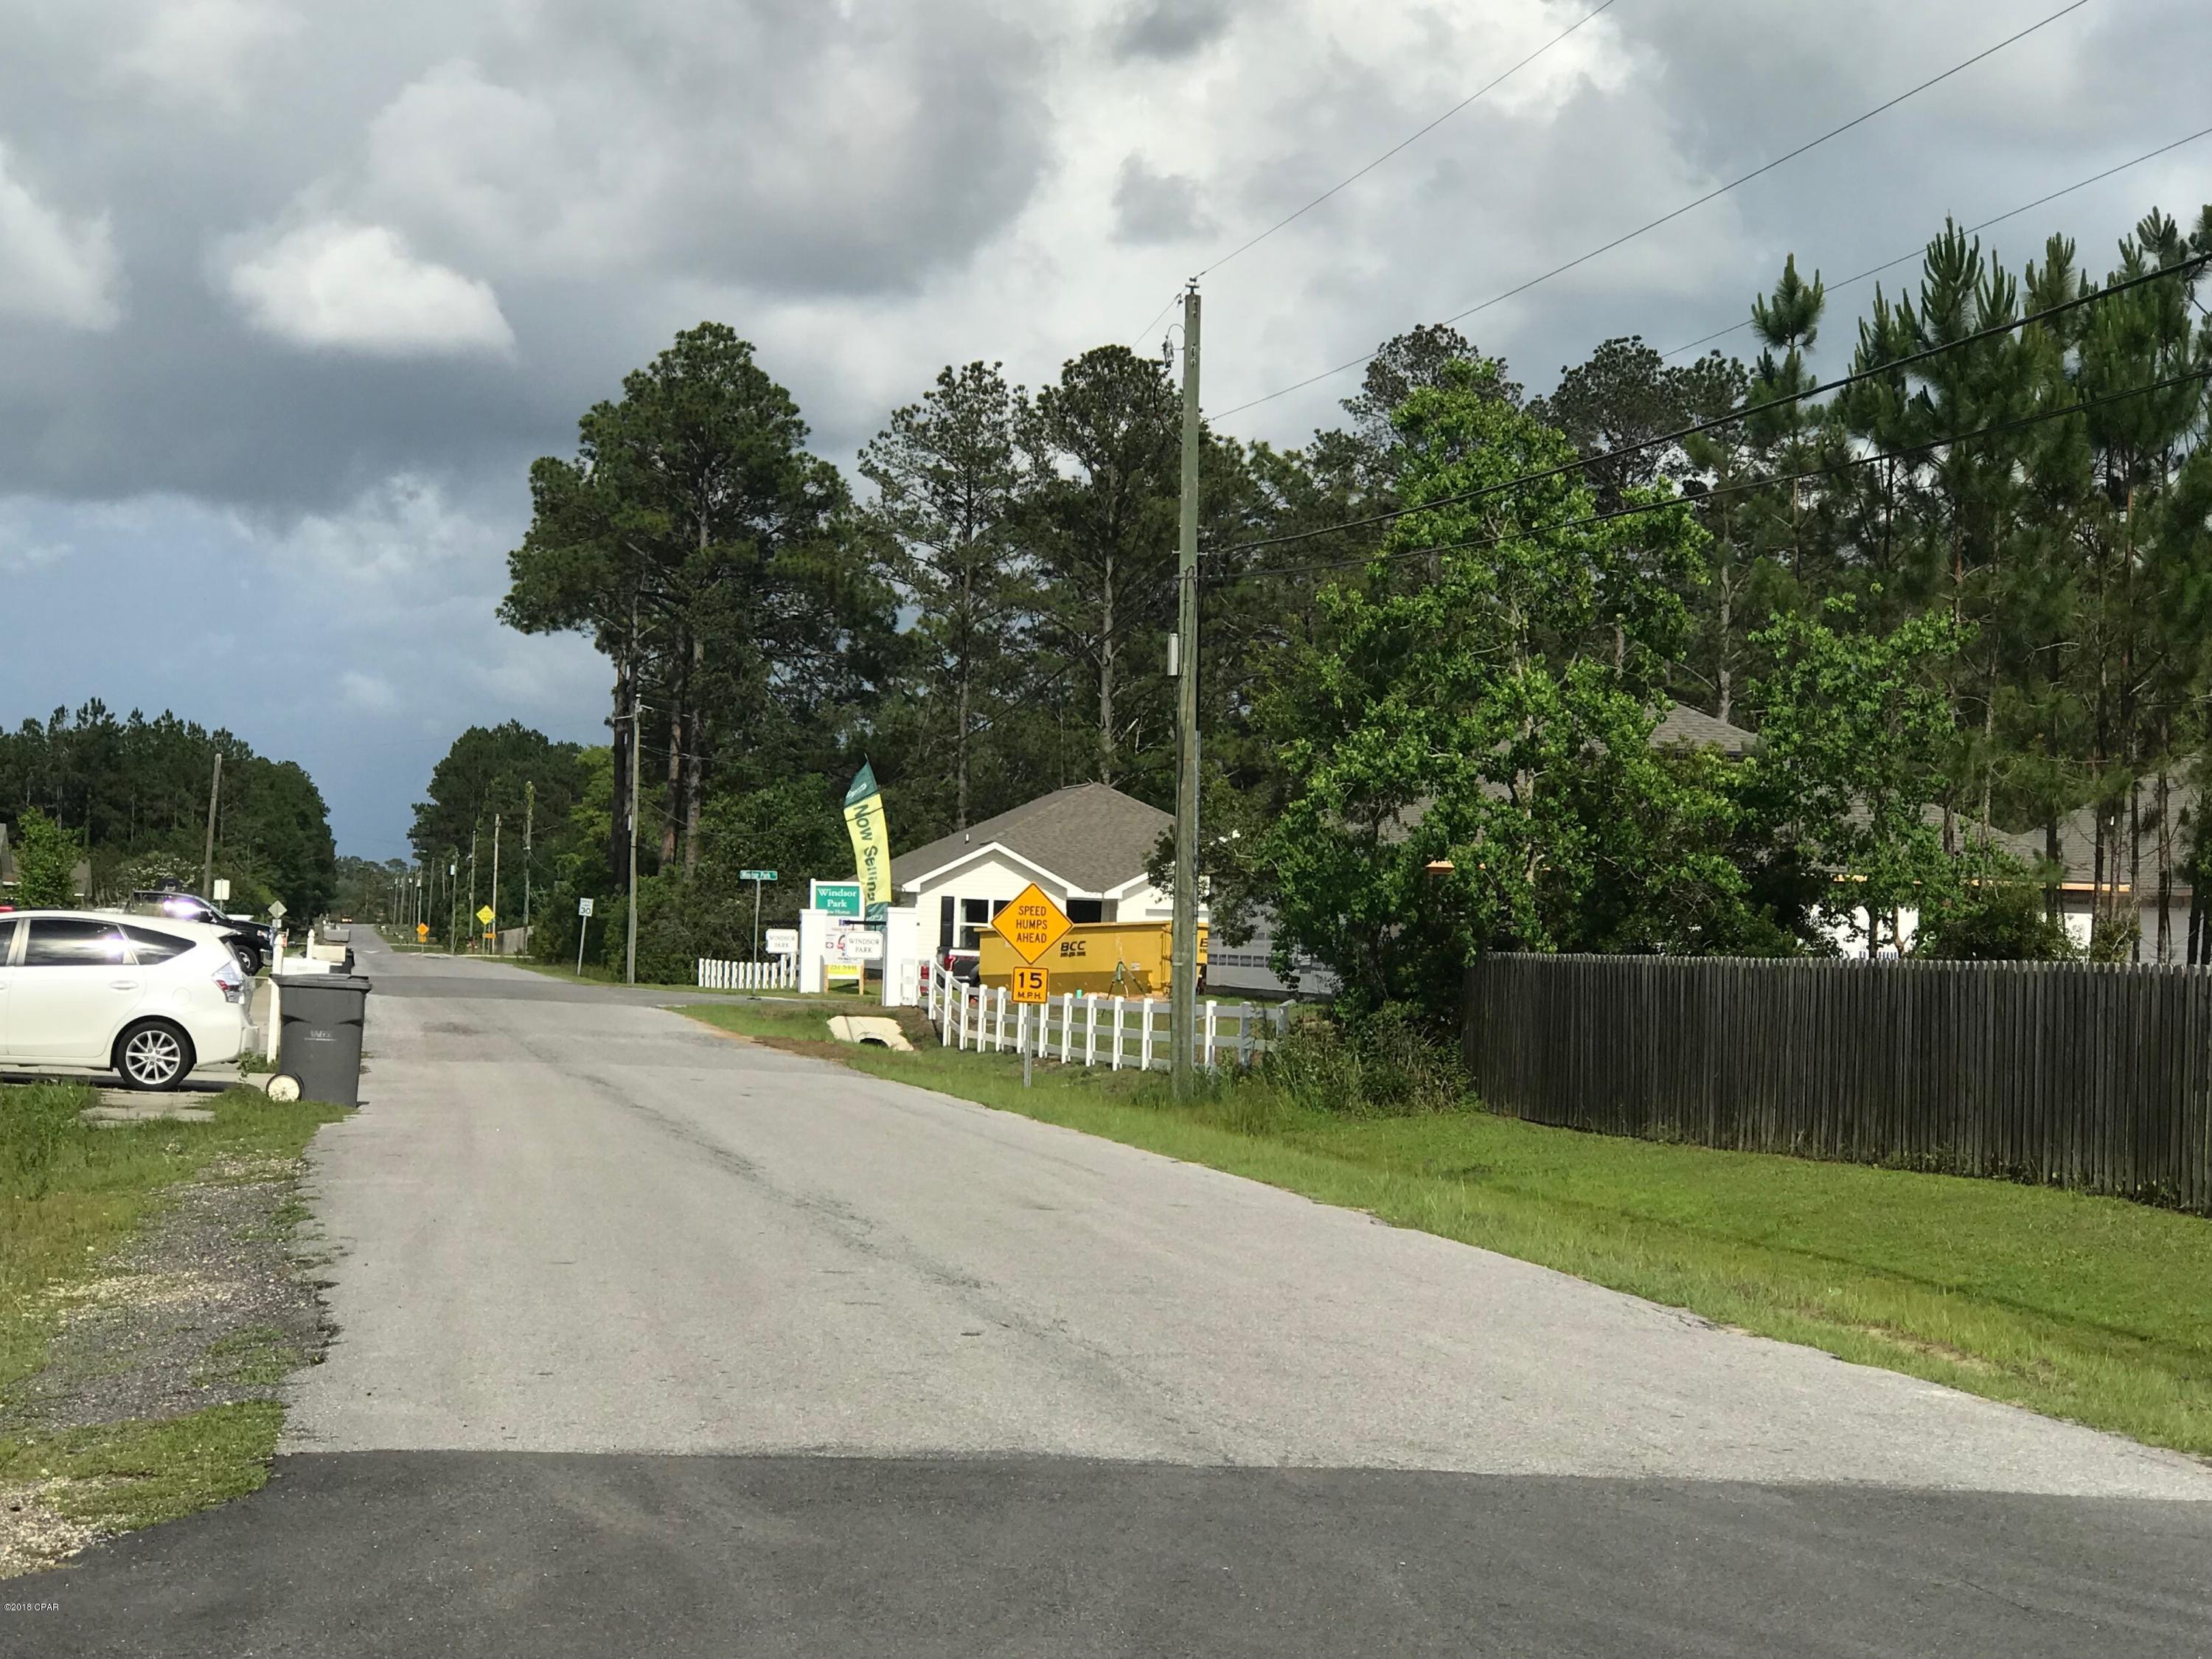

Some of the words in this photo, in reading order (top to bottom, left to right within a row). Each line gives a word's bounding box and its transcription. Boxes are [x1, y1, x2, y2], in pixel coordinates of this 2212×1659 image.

[853, 804, 873, 841] Now
[817, 888, 857, 897] Windsor
[827, 899, 847, 908] Park
[1018, 905, 1046, 916] SPEED
[1016, 919, 1048, 930] HUMPS
[1016, 933, 1047, 943] AHEAD
[1060, 940, 1086, 951] BCC
[1018, 972, 1043, 989] 15
